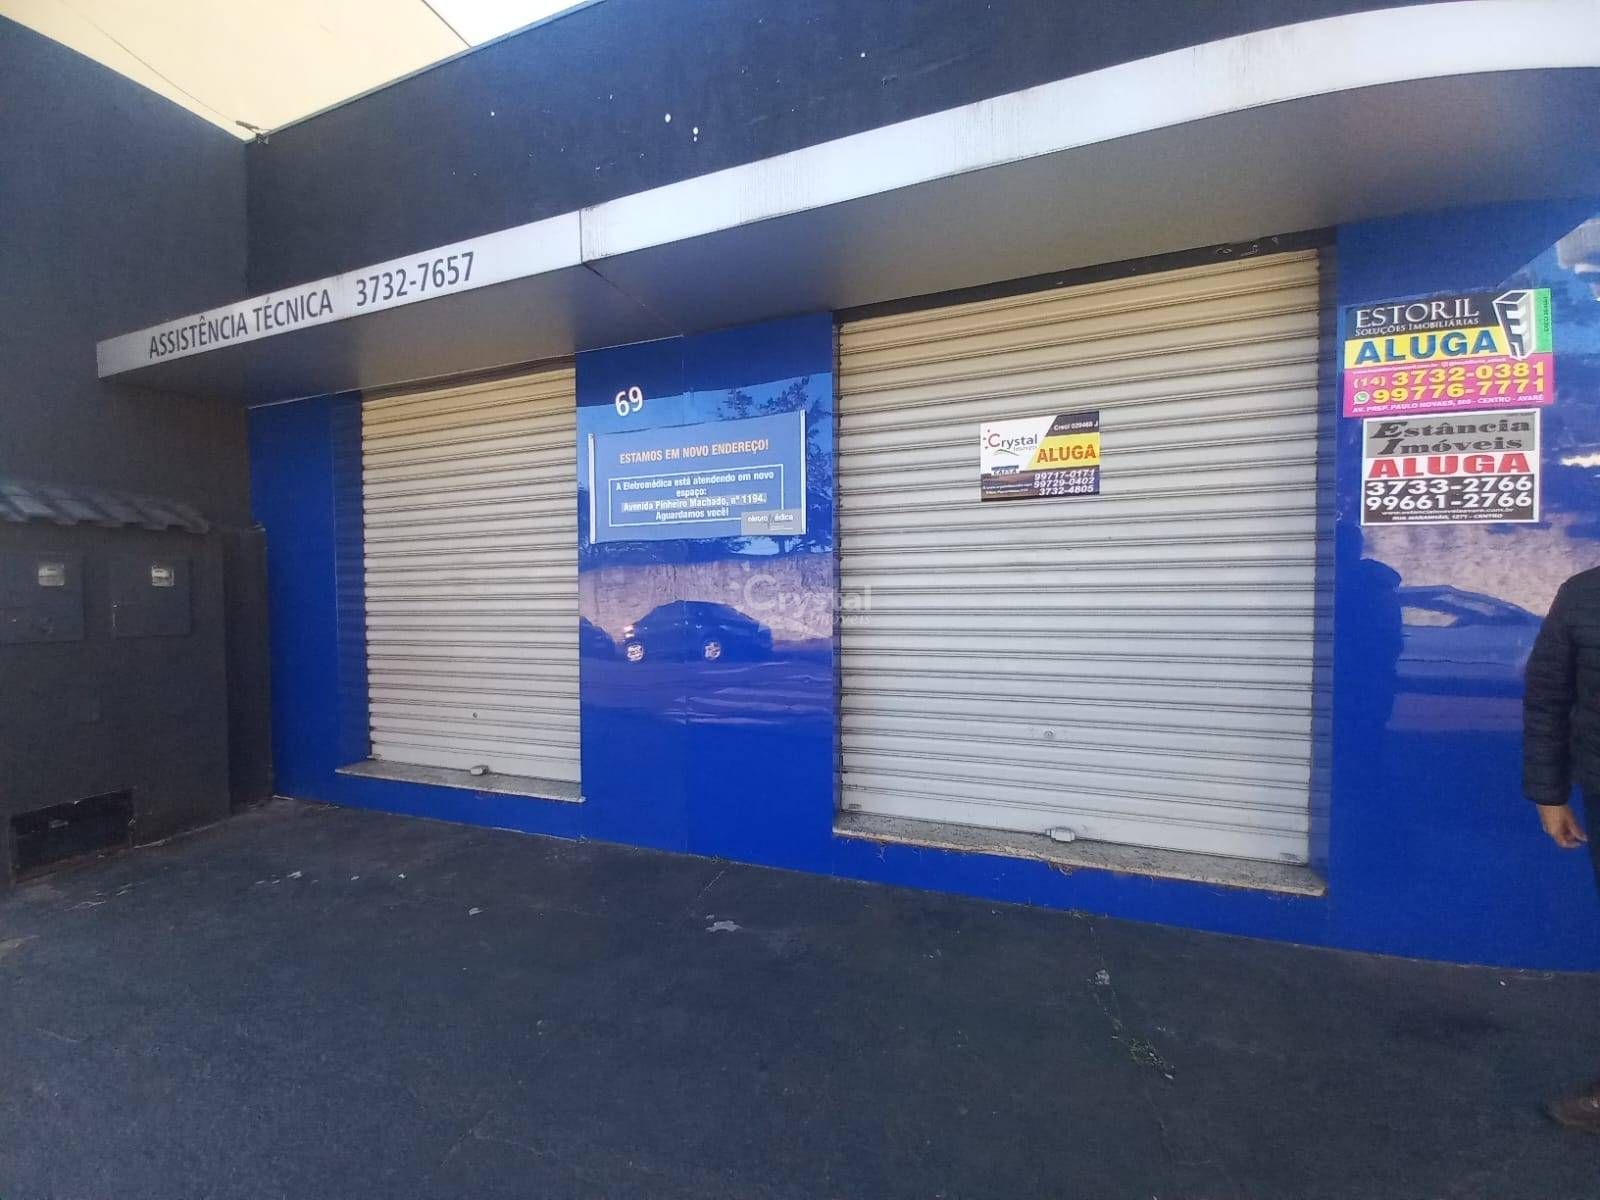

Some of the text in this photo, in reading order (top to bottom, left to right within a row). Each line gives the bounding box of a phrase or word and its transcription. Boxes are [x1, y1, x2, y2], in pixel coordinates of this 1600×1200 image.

[149, 251, 475, 358] ASSISTÊNCIA TÉCNICA 3732-7657
[1355, 297, 1480, 329] ESTORIL
[1354, 329, 1499, 366] ALUGA
[1353, 376, 1386, 389] (14)
[1391, 361, 1545, 387] 3732-0381
[614, 385, 644, 417] 69
[1372, 379, 1545, 404] 99776-7771
[1370, 419, 1530, 439] Estância
[619, 438, 769, 465] ESTAMOS EM NOVO ENDEREÇO!
[987, 433, 1038, 450] Crystal
[1377, 436, 1523, 455] Imóveis
[1036, 443, 1097, 464] ALUGA
[1034, 469, 1095, 481] 99717-0171
[1368, 452, 1531, 479] ALUGA
[615, 482, 623, 491] A
[674, 476, 692, 486] está
[693, 473, 736, 485] atendendo
[754, 471, 774, 480] novo
[1033, 477, 1095, 489] 99729-0402
[1039, 485, 1094, 496] 3732-4805
[1365, 476, 1533, 496] 3733-2766
[623, 501, 653, 512] Avenida
[655, 498, 688, 510] Pinheiro
[689, 495, 729, 508] Machado,
[742, 493, 767, 504] 1194.
[676, 487, 707, 498] espaço:
[1365, 492, 1533, 511] 99661-2766
[655, 507, 729, 521] Aguardamos você!
